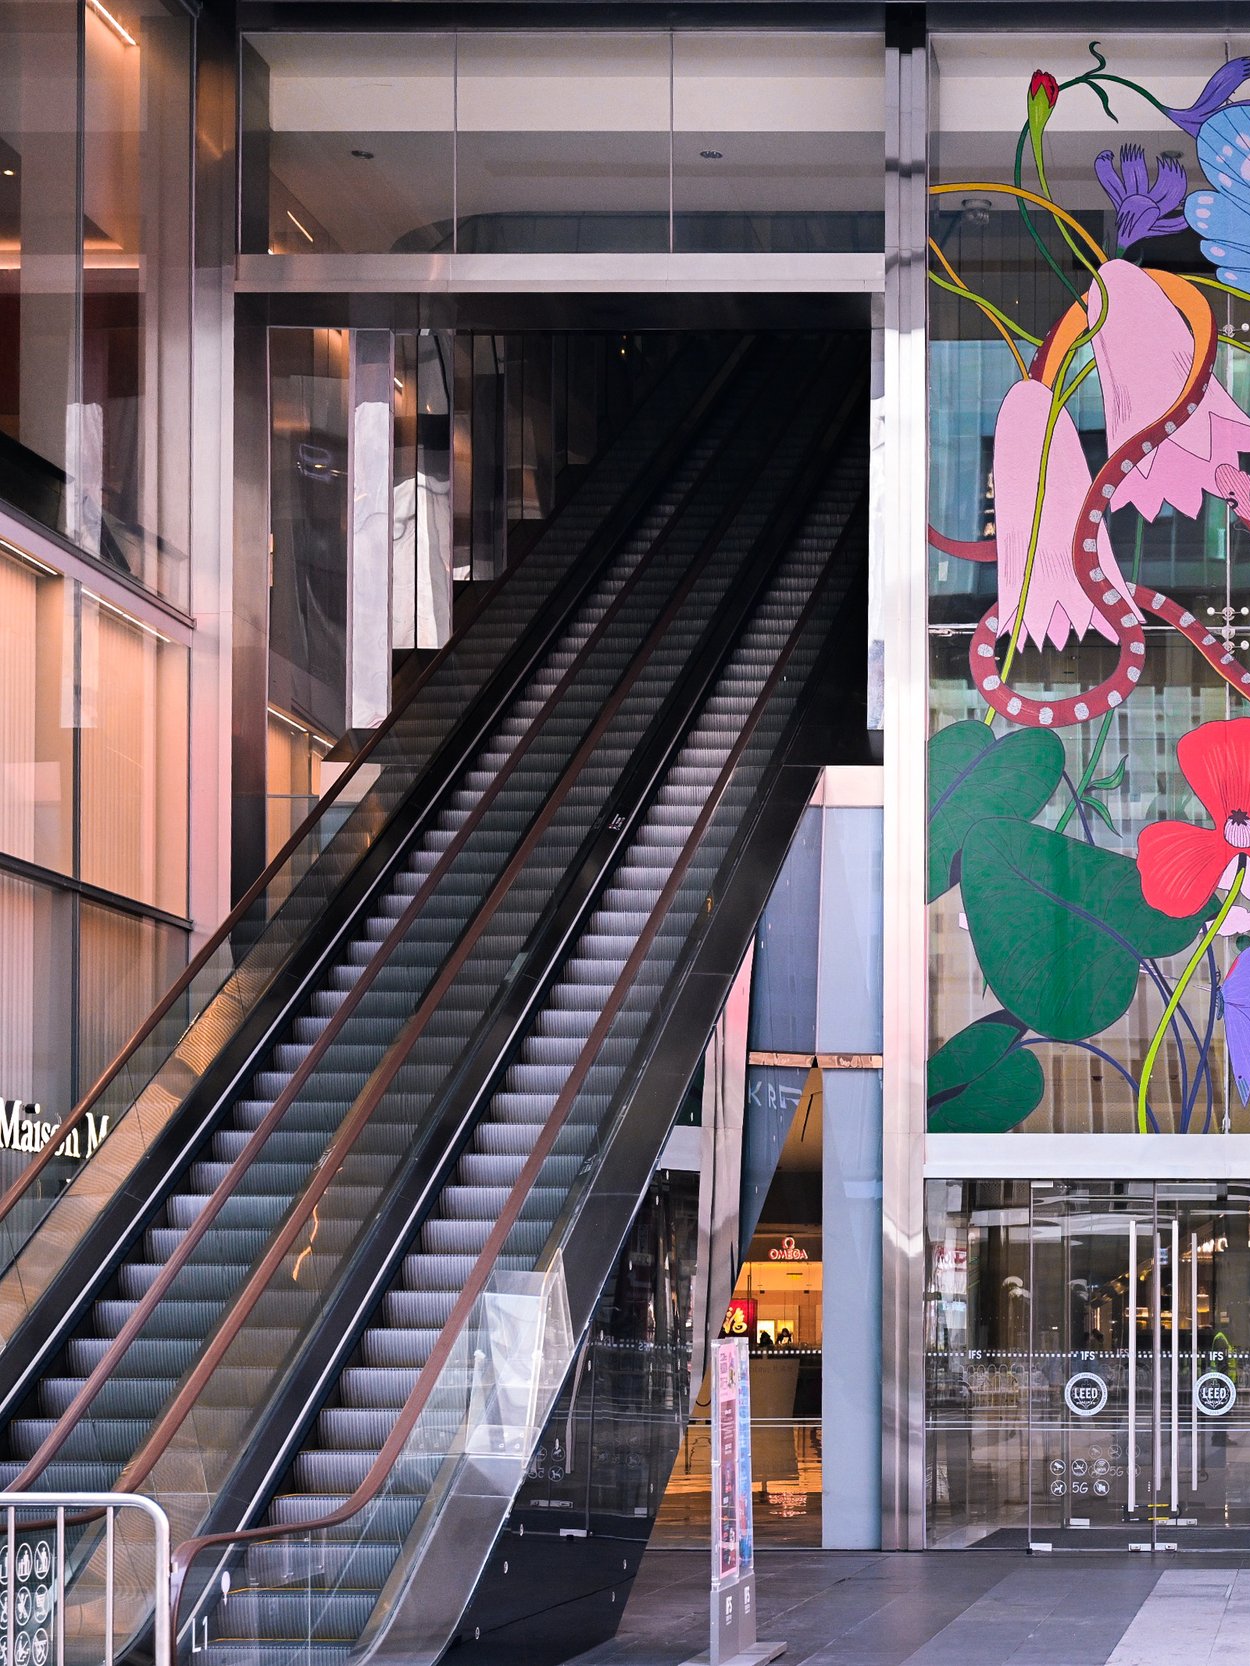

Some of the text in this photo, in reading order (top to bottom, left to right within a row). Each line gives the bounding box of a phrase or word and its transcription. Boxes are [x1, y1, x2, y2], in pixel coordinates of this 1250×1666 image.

[768, 1248, 808, 1260] OMEGA
[968, 1350, 982, 1359] IFS
[1209, 1352, 1224, 1361] IFS
[1074, 1387, 1098, 1399] LEED
[1202, 1387, 1226, 1399] LEED
[1072, 1481, 1089, 1494] 5G
[191, 1615, 208, 1653] L1
